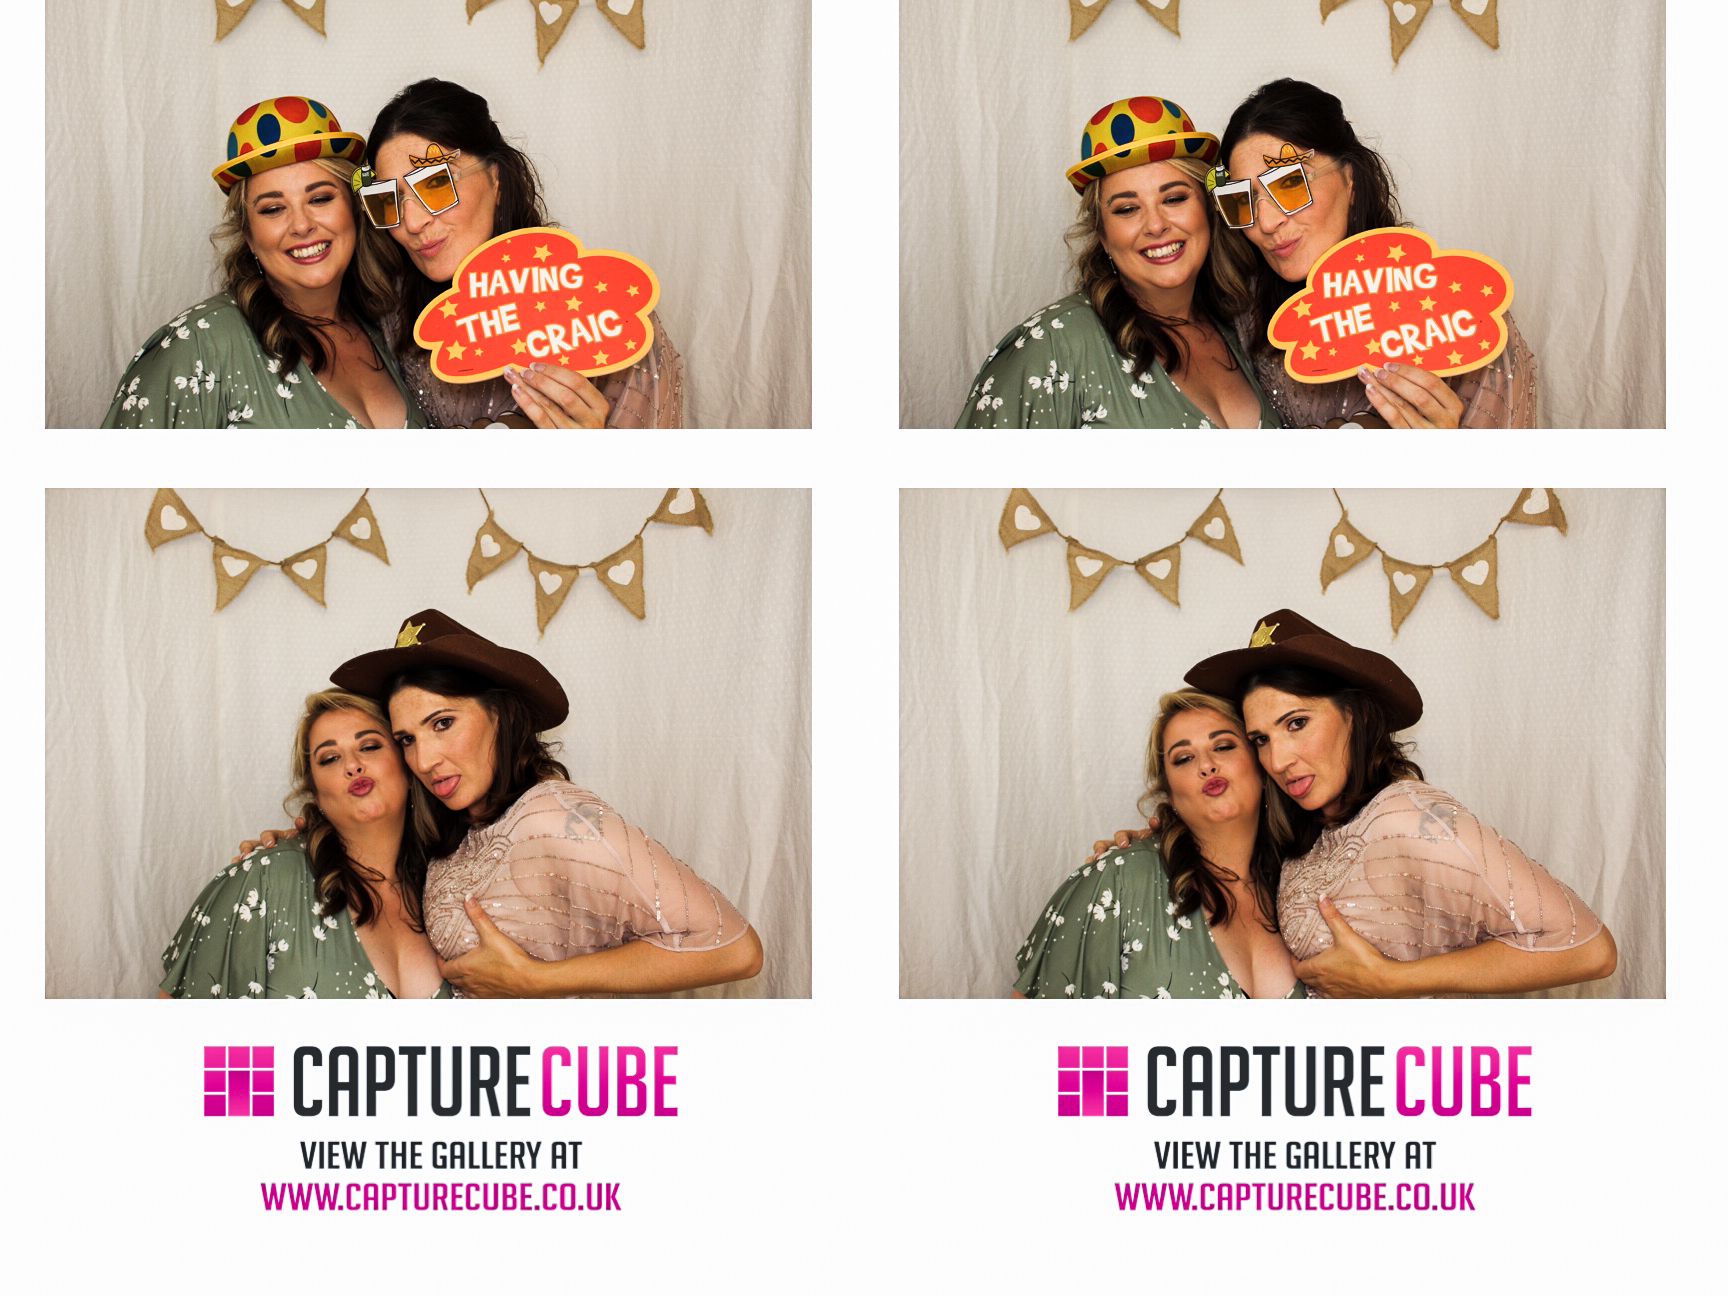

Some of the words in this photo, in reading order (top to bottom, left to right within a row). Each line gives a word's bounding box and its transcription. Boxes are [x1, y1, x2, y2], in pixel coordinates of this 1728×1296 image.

[468, 262, 584, 299] HAVING
[1322, 262, 1438, 299] HAVING
[455, 302, 521, 344] THE
[525, 309, 624, 359] CRAIC
[1309, 302, 1375, 344] THE
[1379, 309, 1478, 359] CRAIC
